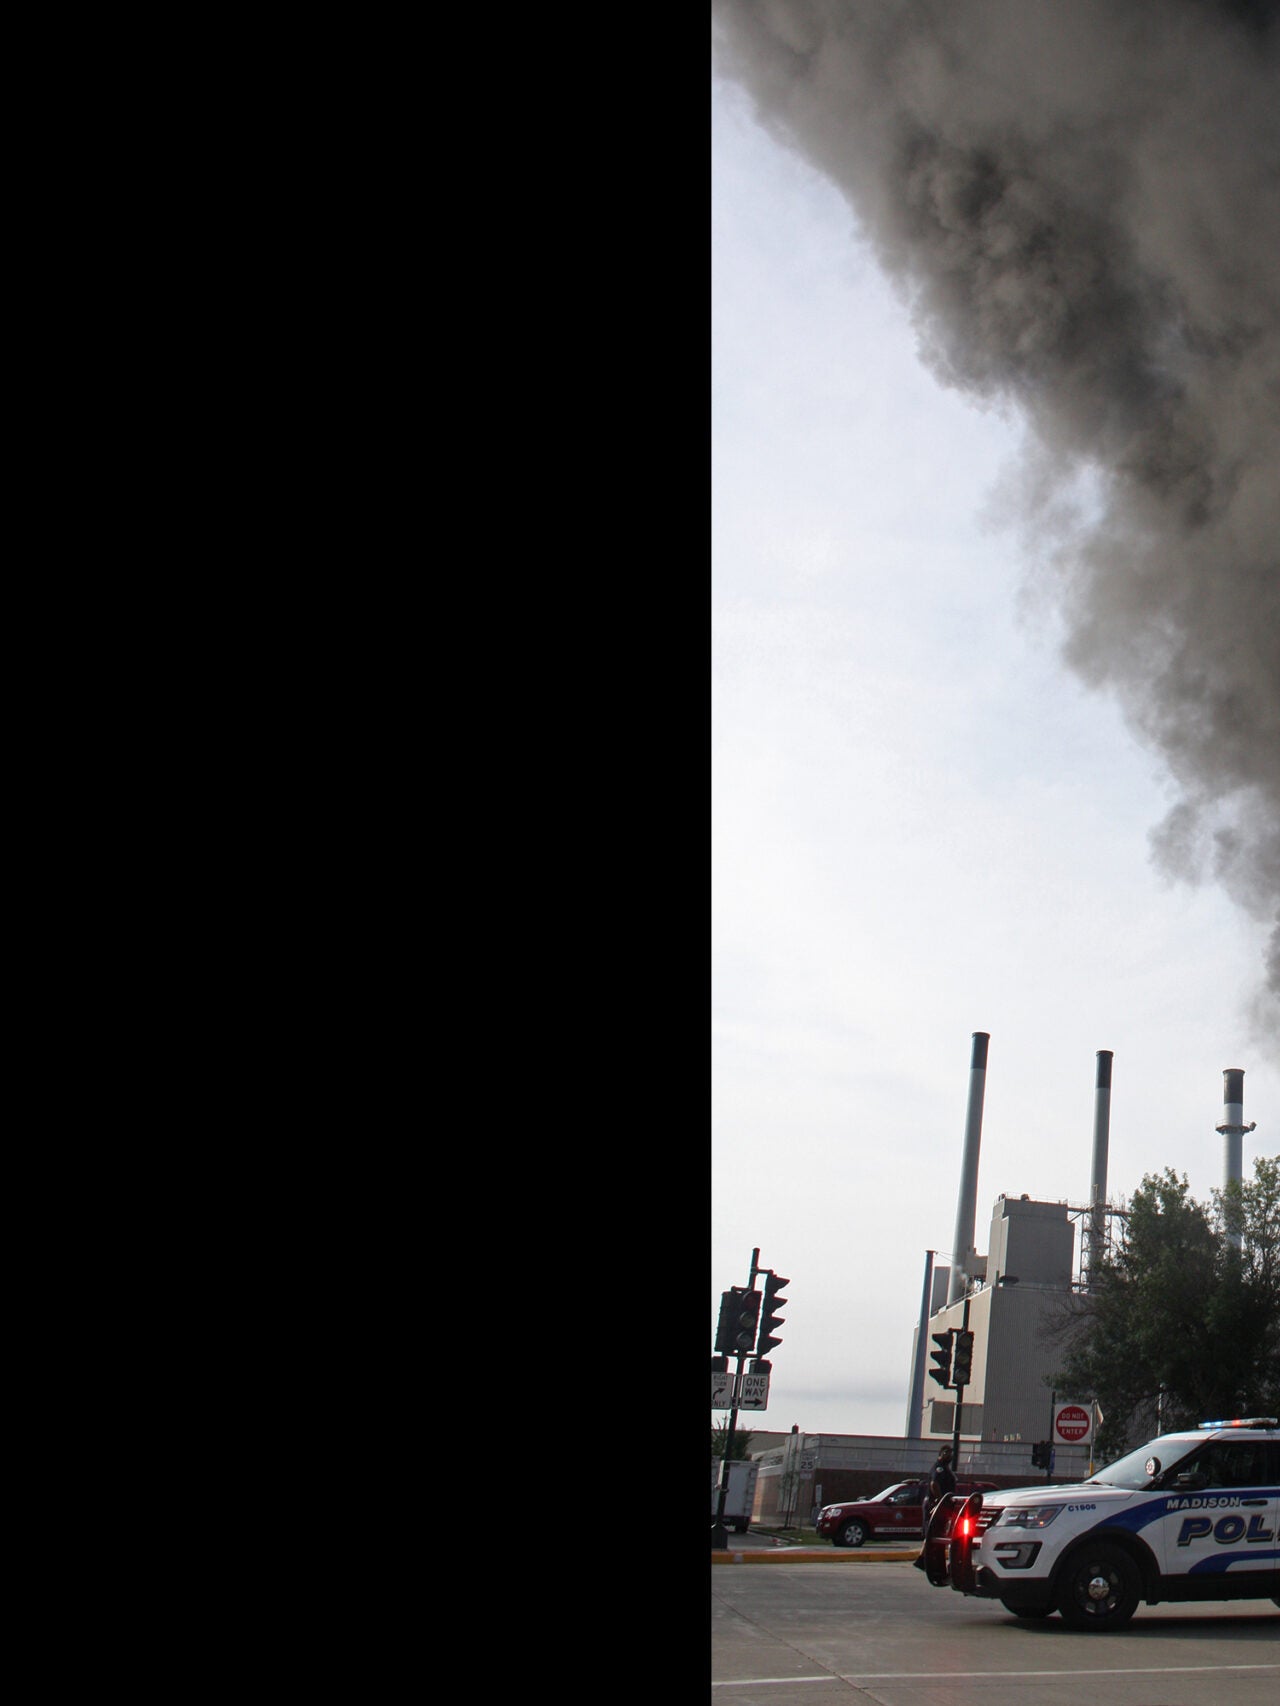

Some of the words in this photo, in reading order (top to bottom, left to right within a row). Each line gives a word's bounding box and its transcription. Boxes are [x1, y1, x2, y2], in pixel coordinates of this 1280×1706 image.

[746, 1377, 766, 1387] ONE
[744, 1387, 765, 1397] WAY
[800, 1461, 814, 1470] 25
[1166, 1496, 1240, 1510] MADISON
